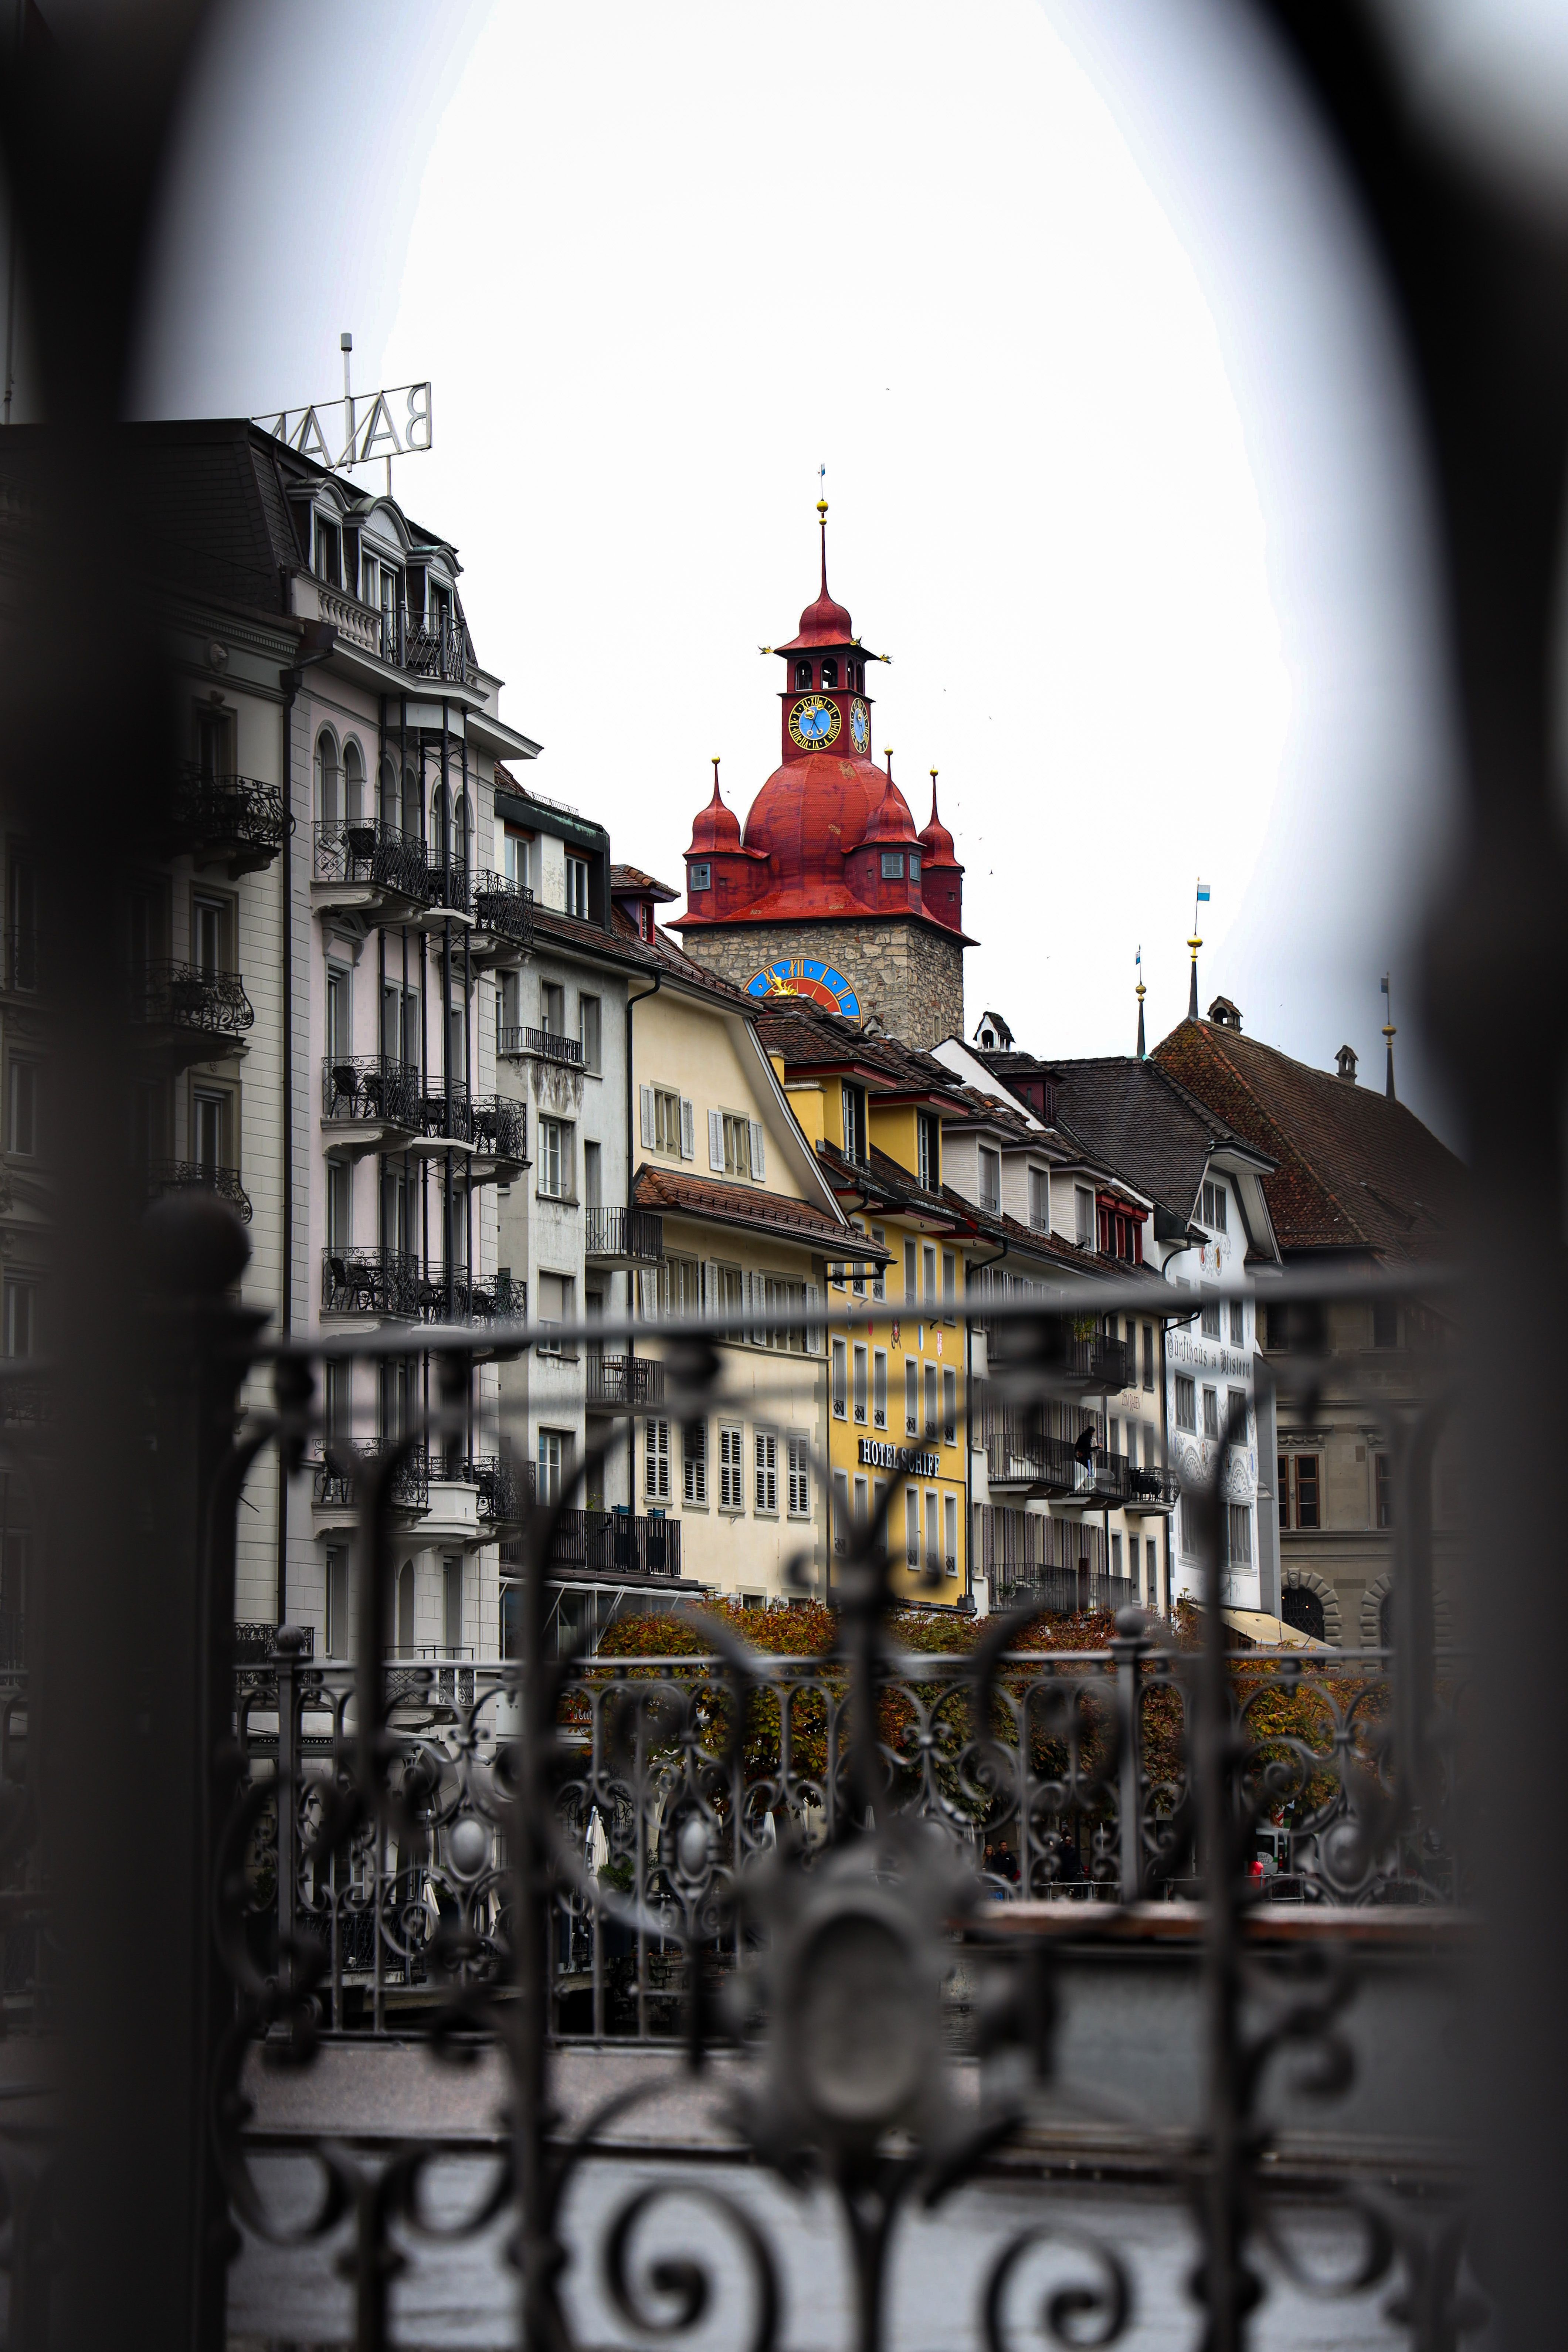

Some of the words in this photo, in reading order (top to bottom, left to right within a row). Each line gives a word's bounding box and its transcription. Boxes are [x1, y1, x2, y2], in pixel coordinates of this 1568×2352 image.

[788, 959, 805, 977] XII
[863, 1439, 899, 1470] HOTEL
[901, 1447, 940, 1477] SCHIFF
